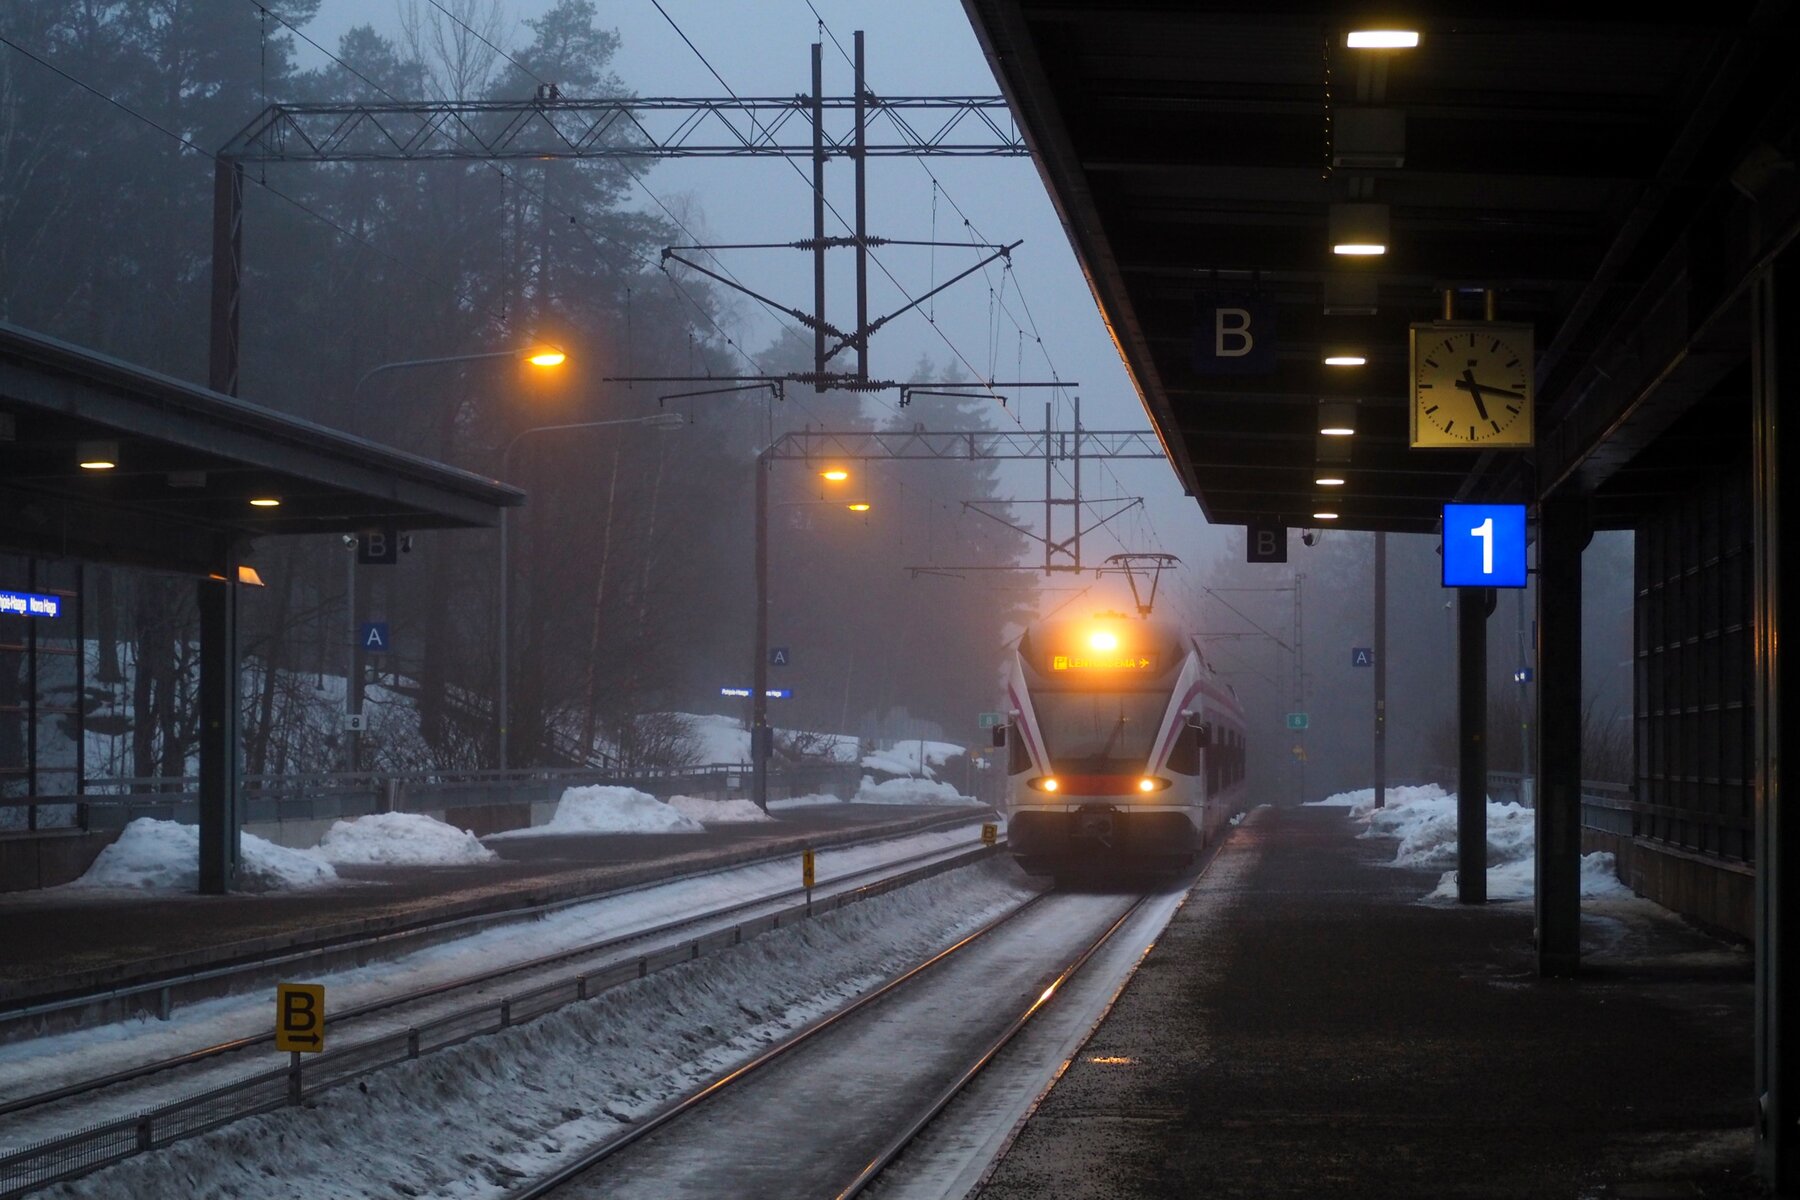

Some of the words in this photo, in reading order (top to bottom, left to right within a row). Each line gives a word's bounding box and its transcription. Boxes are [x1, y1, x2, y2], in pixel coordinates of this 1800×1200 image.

[1215, 308, 1254, 357] B
[368, 532, 386, 557] B
[1257, 531, 1276, 555] B
[1470, 518, 1493, 574] 1
[367, 627, 382, 646] A
[775, 650, 785, 664] A
[1356, 650, 1367, 664] A
[351, 717, 360, 728] 8
[984, 825, 995, 839] B
[283, 991, 316, 1031] B
